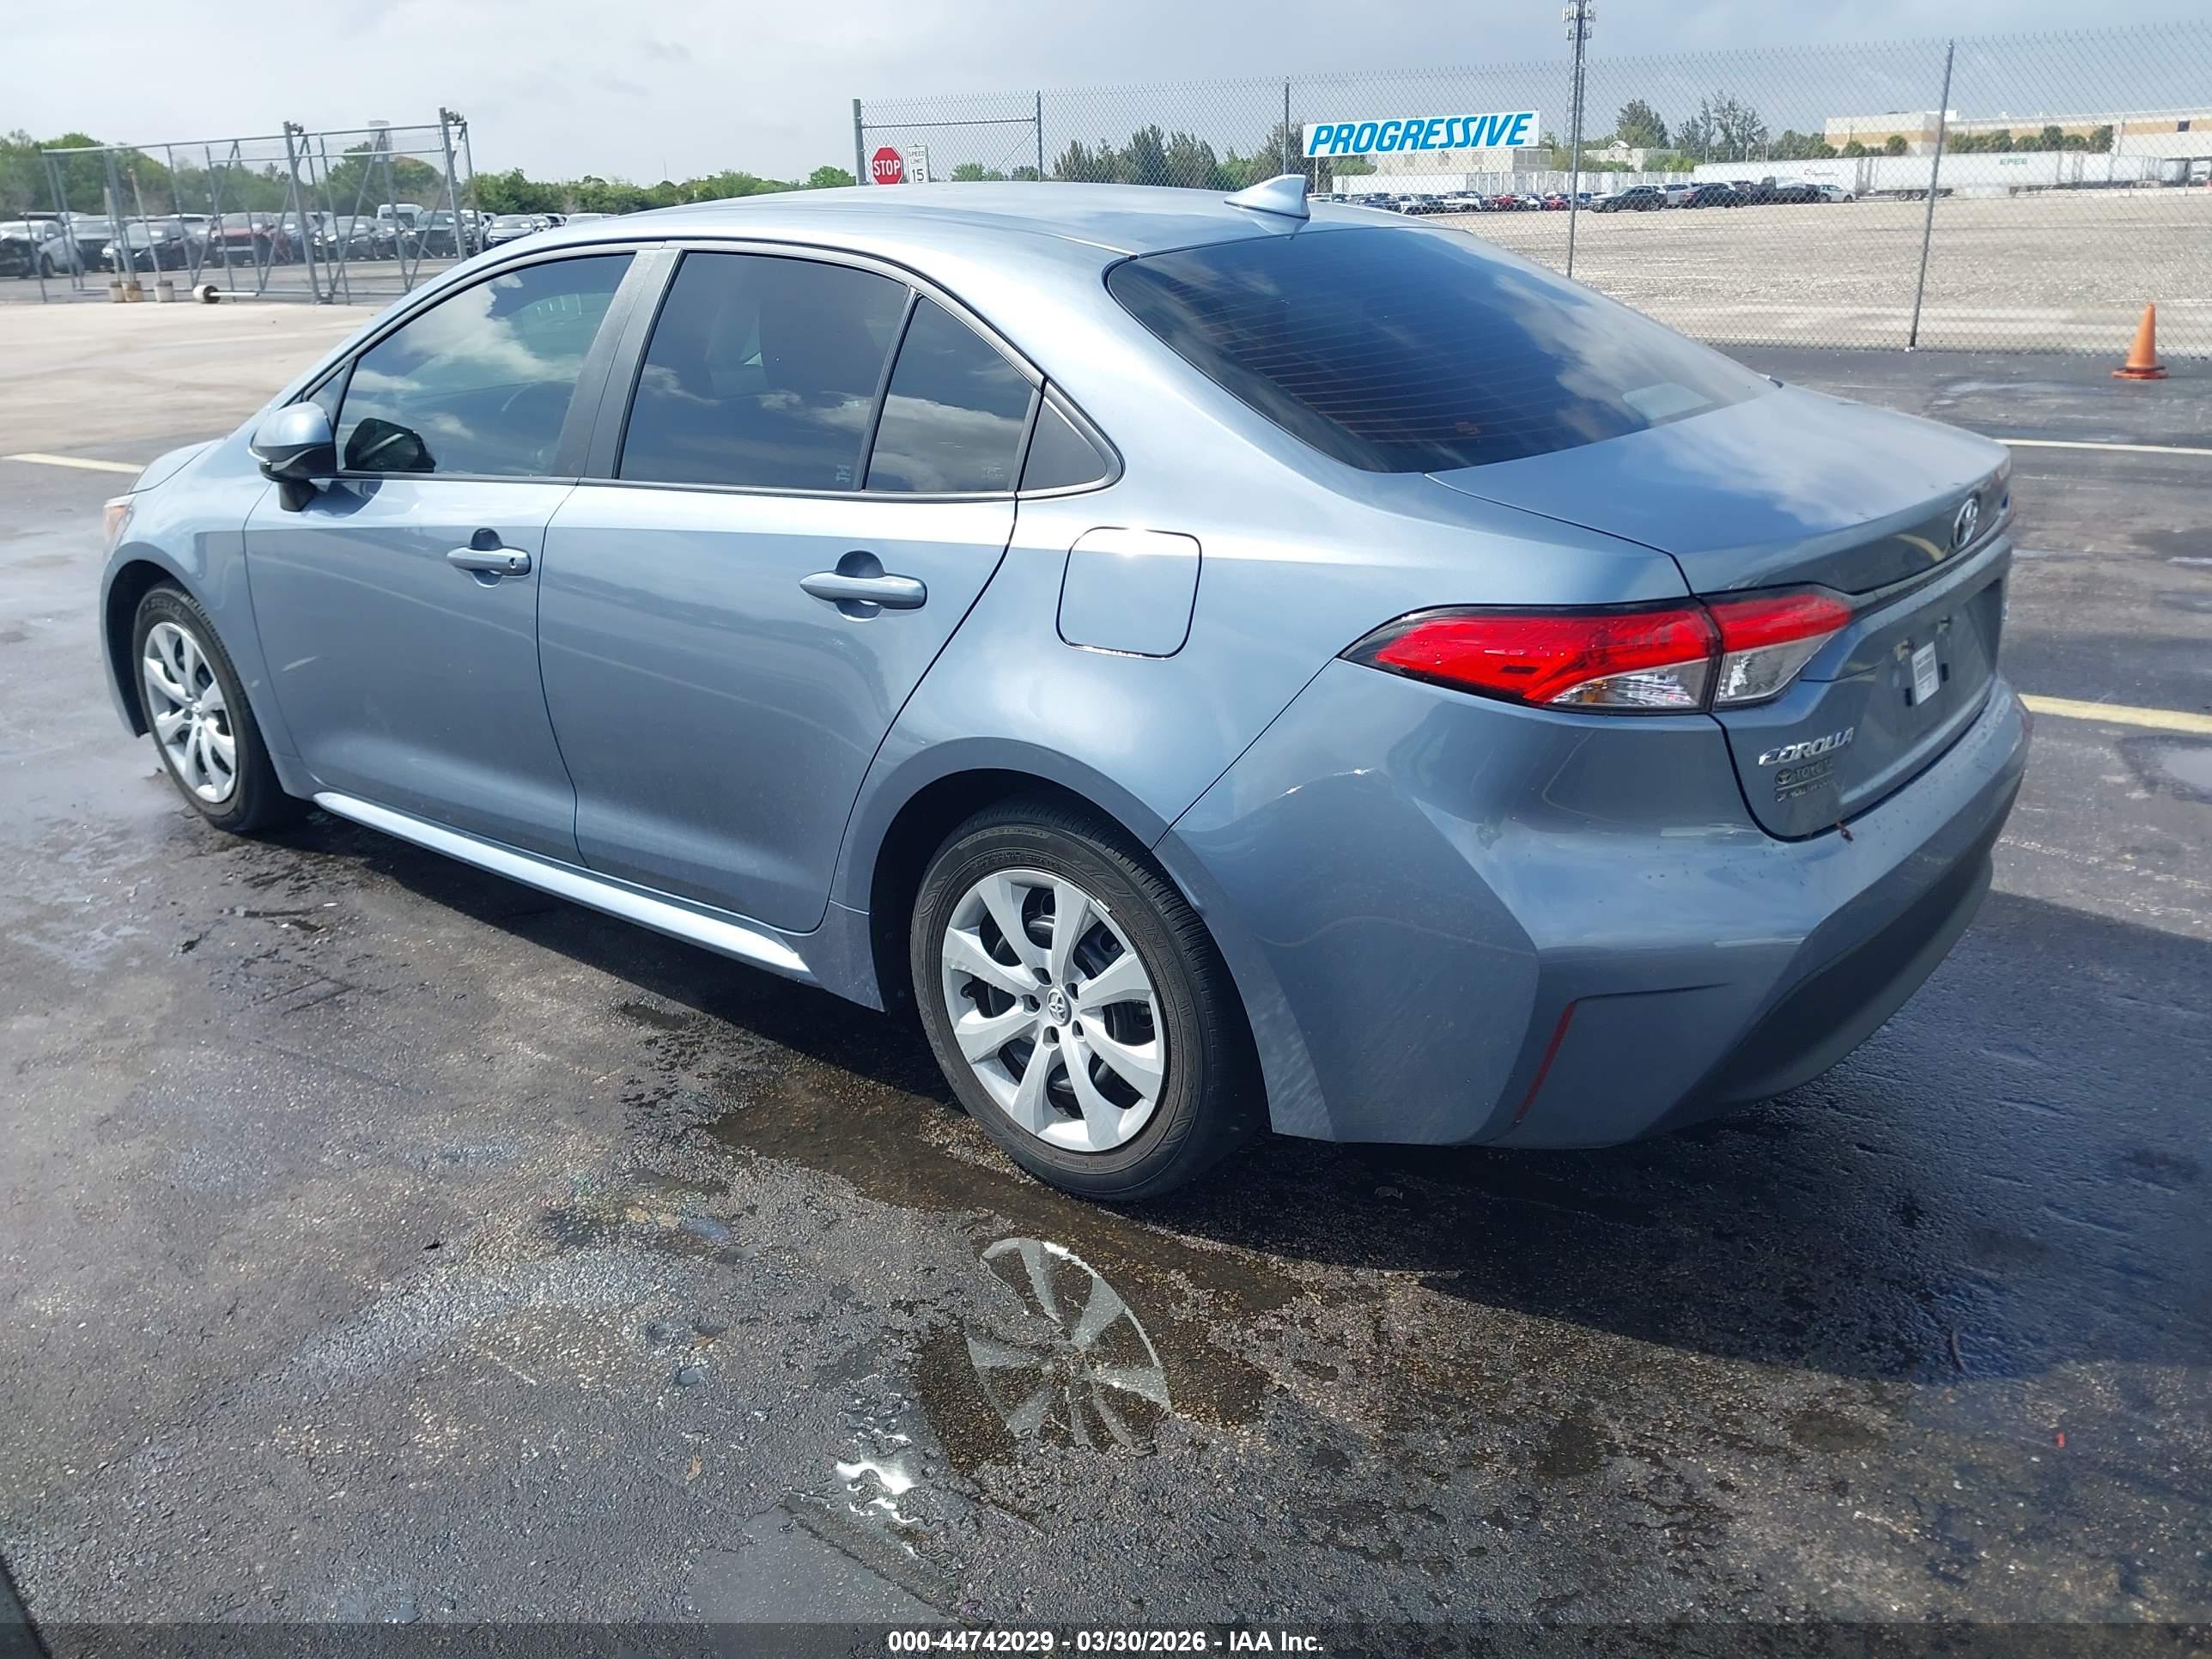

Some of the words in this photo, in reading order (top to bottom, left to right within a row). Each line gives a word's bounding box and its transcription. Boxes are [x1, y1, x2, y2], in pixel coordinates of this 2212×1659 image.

[1309, 113, 1533, 155] PROGRESSIVE
[873, 160, 901, 176] STOP
[912, 168, 925, 182] 15
[1758, 727, 1855, 766] COROLLA
